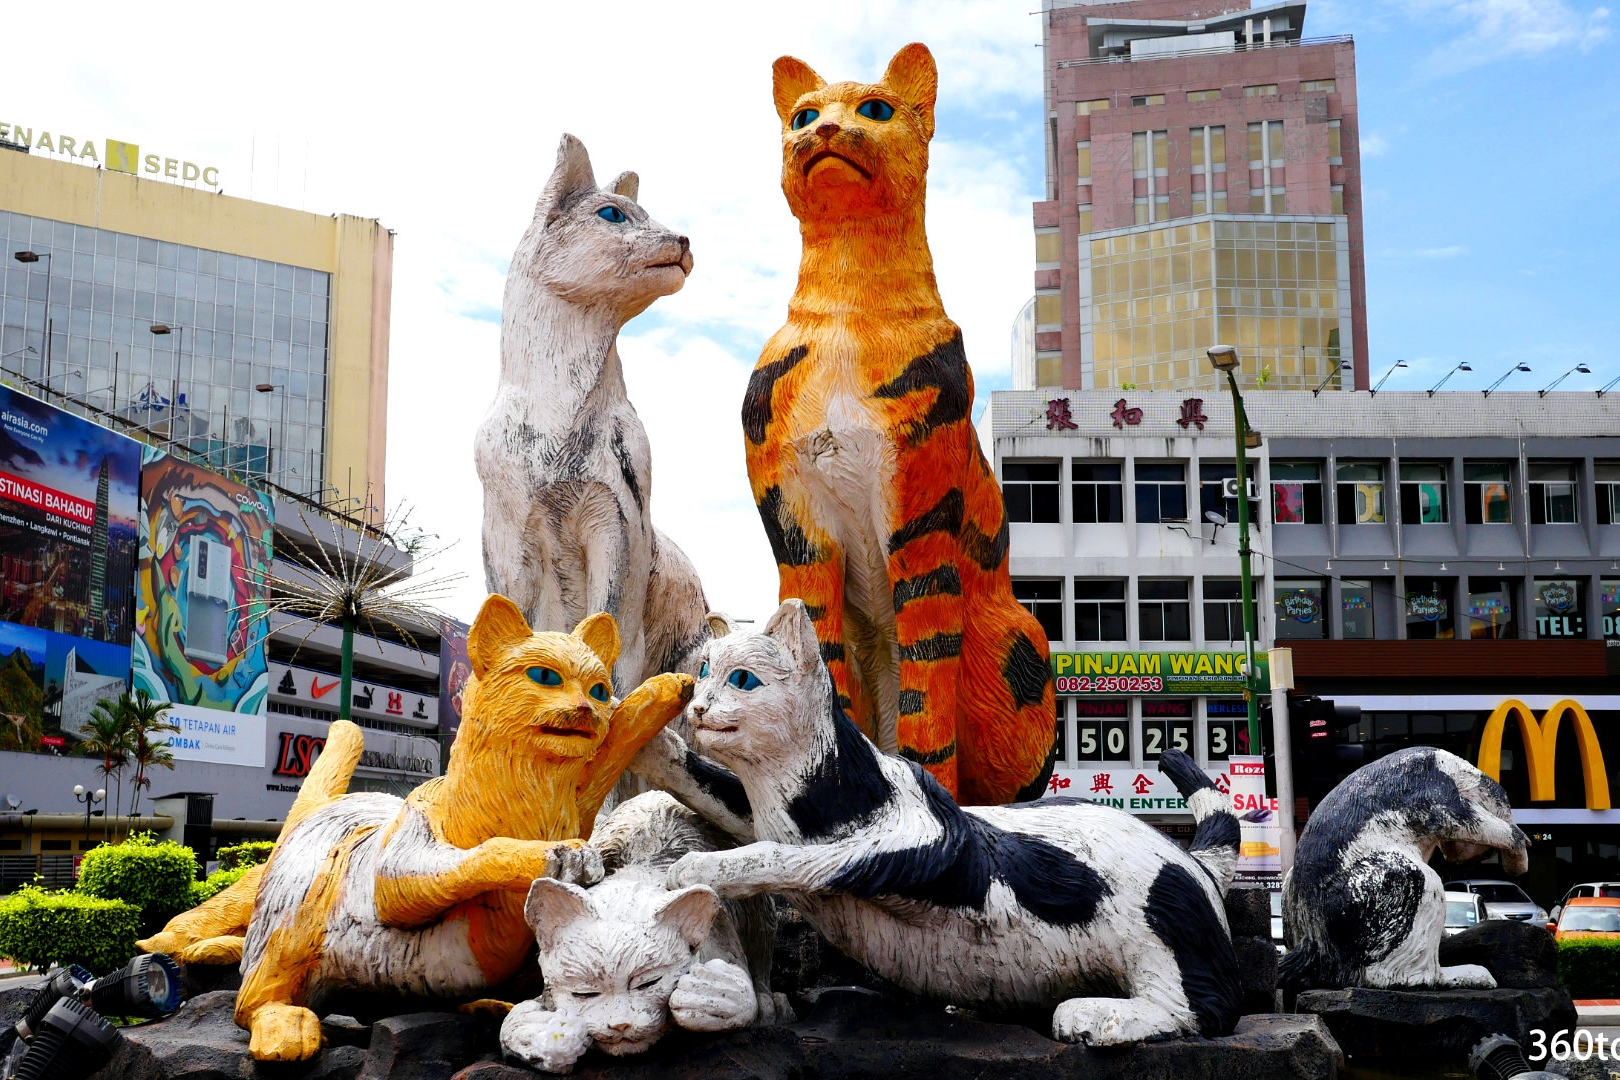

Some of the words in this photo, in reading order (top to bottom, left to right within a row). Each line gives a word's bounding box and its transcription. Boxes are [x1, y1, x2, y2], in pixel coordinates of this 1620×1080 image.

[145, 154, 219, 187] SEDC
[1, 411, 48, 437] airasia.com
[0, 478, 42, 504] STINASI
[45, 493, 92, 520] BAHARU!
[46, 513, 62, 525] DARI
[63, 519, 91, 534] KUCHING
[30, 521, 57, 537] Langkawi
[63, 532, 90, 546] Pontianak
[1285, 596, 1314, 607] Birthday
[1411, 595, 1440, 605] Birthday
[1287, 606, 1312, 615] Parties
[1413, 605, 1438, 615] Parties
[1536, 616, 1582, 636] TEL:
[1056, 654, 1161, 675] PINJAM
[1056, 676, 1163, 692] 082-250253
[1077, 703, 1126, 715] PINJAM
[1145, 703, 1186, 715] WANG
[183, 719, 220, 734] TETAPAN
[222, 724, 236, 735] AIR
[1233, 793, 1279, 811] SALE
